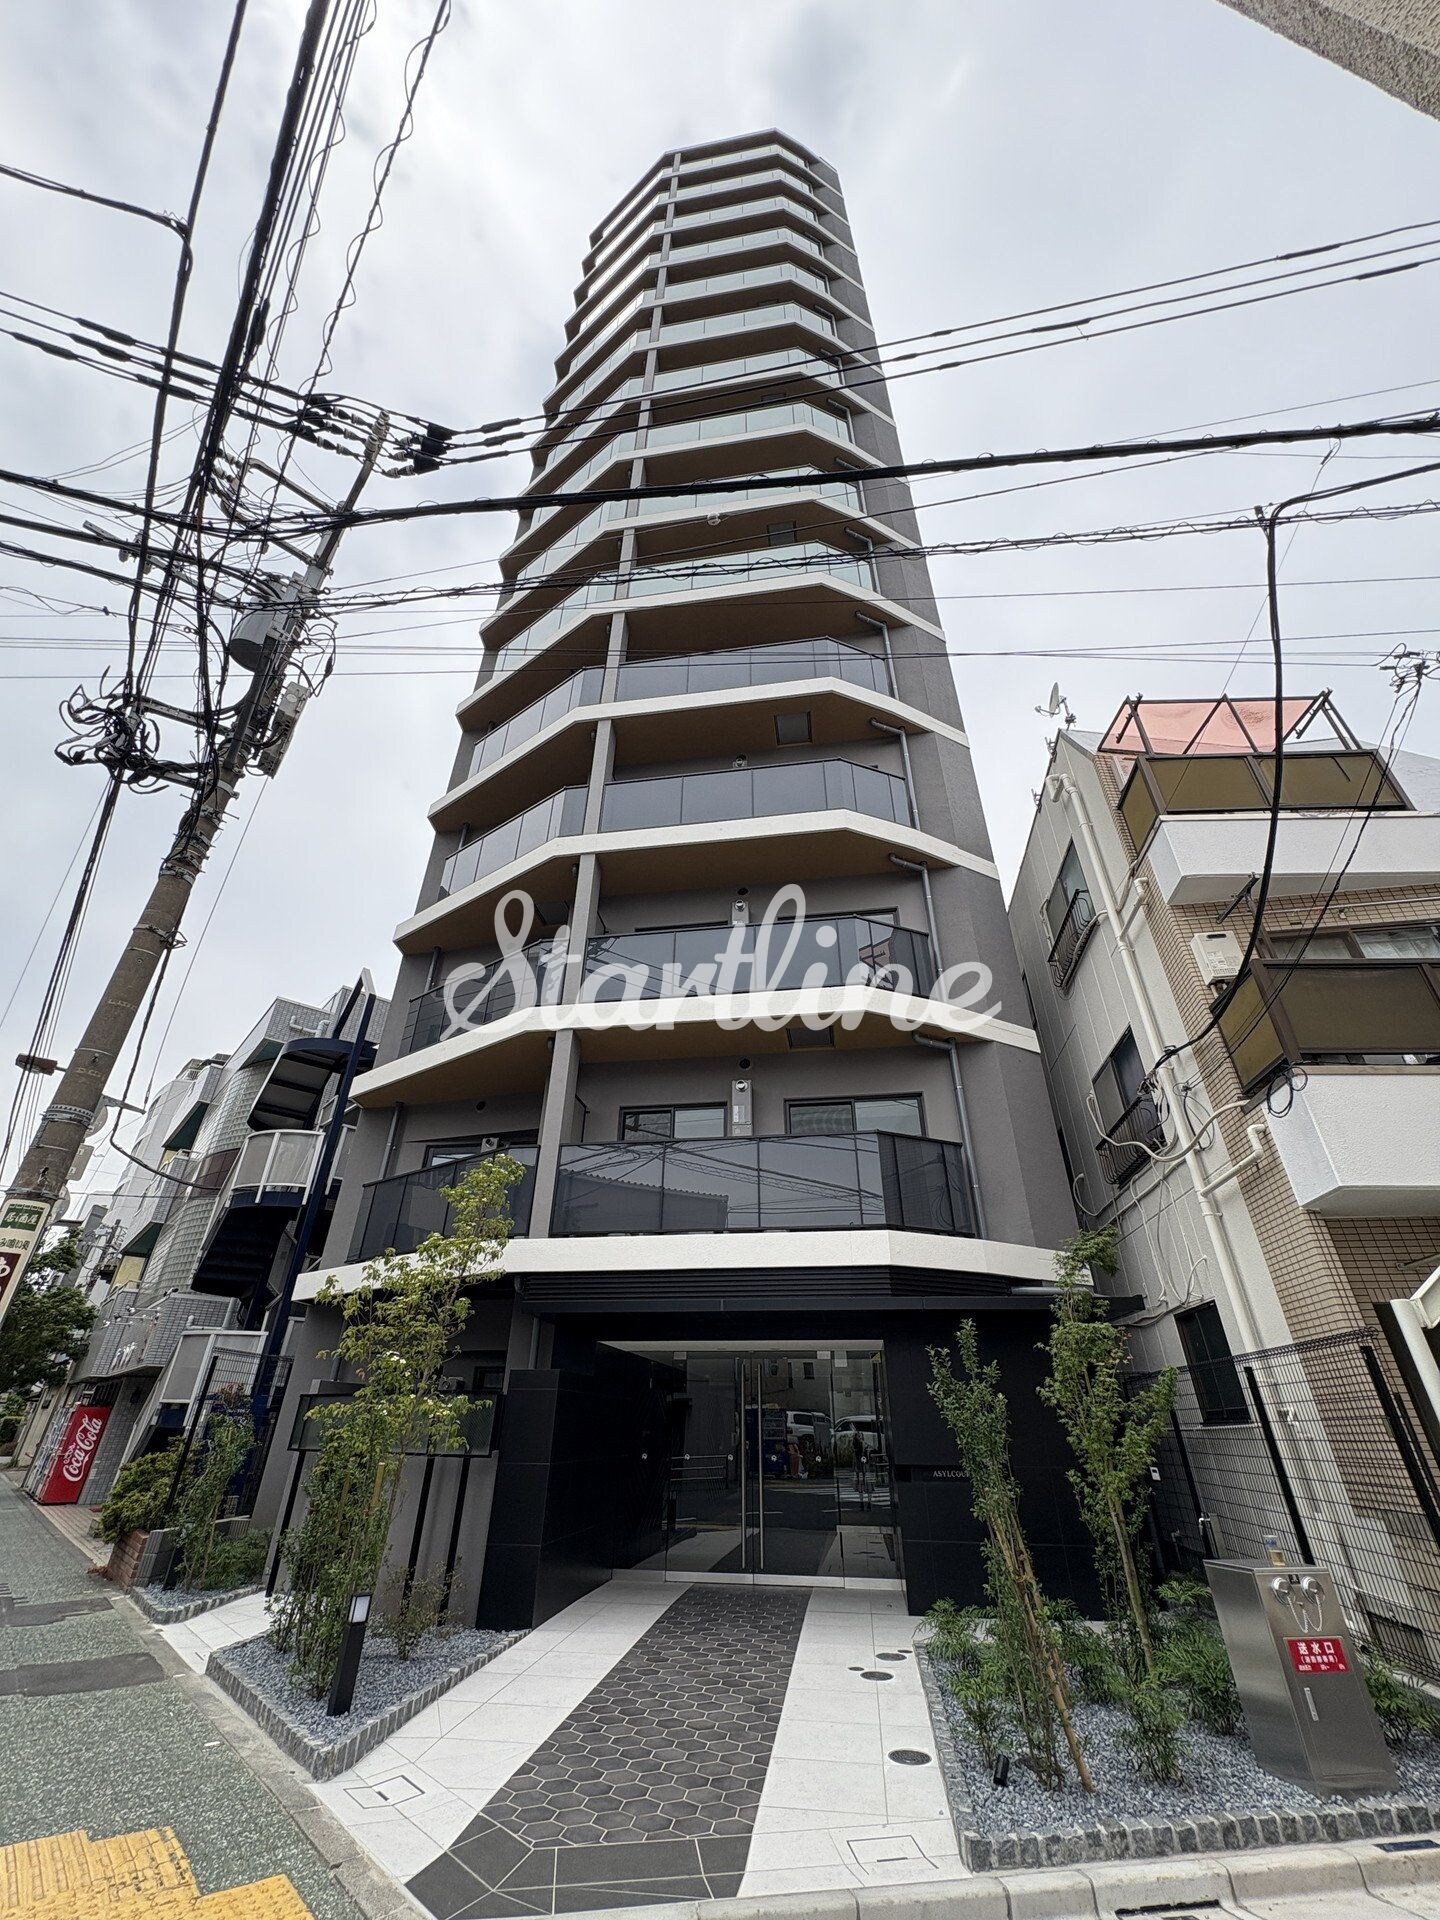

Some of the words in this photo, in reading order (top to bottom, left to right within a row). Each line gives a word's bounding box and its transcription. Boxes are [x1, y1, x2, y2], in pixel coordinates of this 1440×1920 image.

[5, 1212, 39, 1225] 居酒屋
[1297, 1641, 1334, 1655] 送水口
